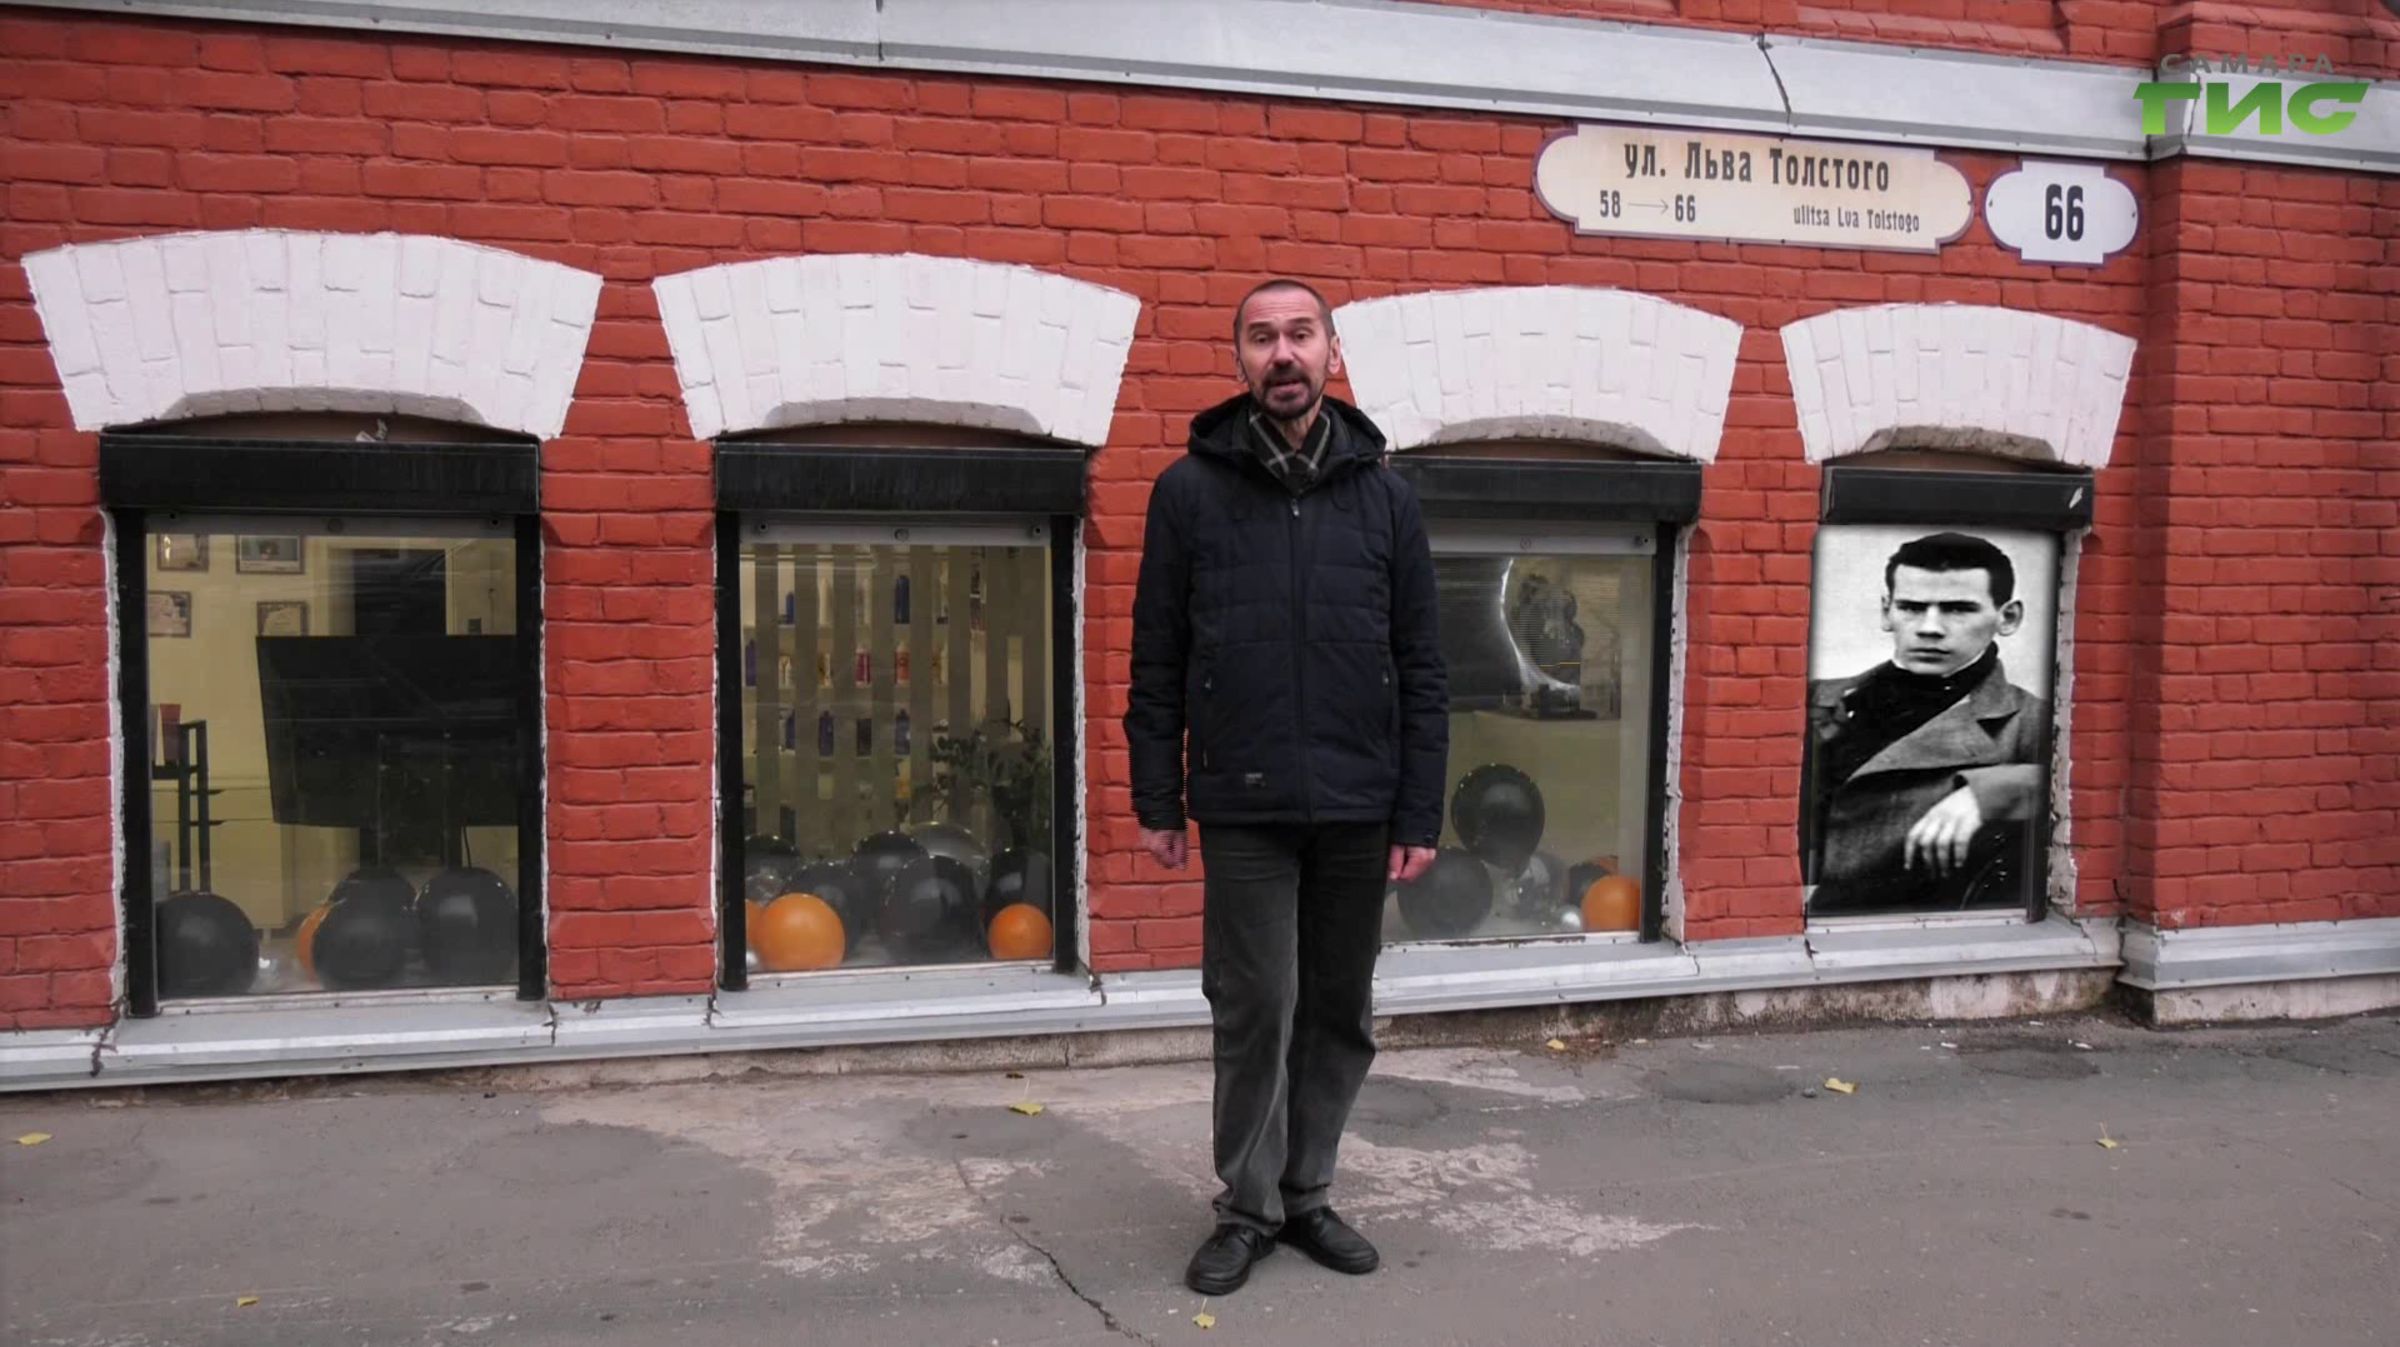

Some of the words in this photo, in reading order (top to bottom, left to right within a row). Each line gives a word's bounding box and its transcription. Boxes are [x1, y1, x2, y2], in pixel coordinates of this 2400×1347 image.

[1624, 143, 1666, 180] ул.
[1684, 141, 1752, 184] Льва
[1770, 147, 1891, 192] Толстого
[1600, 189, 1622, 219] 58
[1674, 194, 1697, 224] 66
[1794, 204, 1831, 227] ulitsa
[1838, 208, 1861, 230] Lva
[1867, 210, 1921, 235] Tolstogo
[2045, 184, 2085, 241] 66
